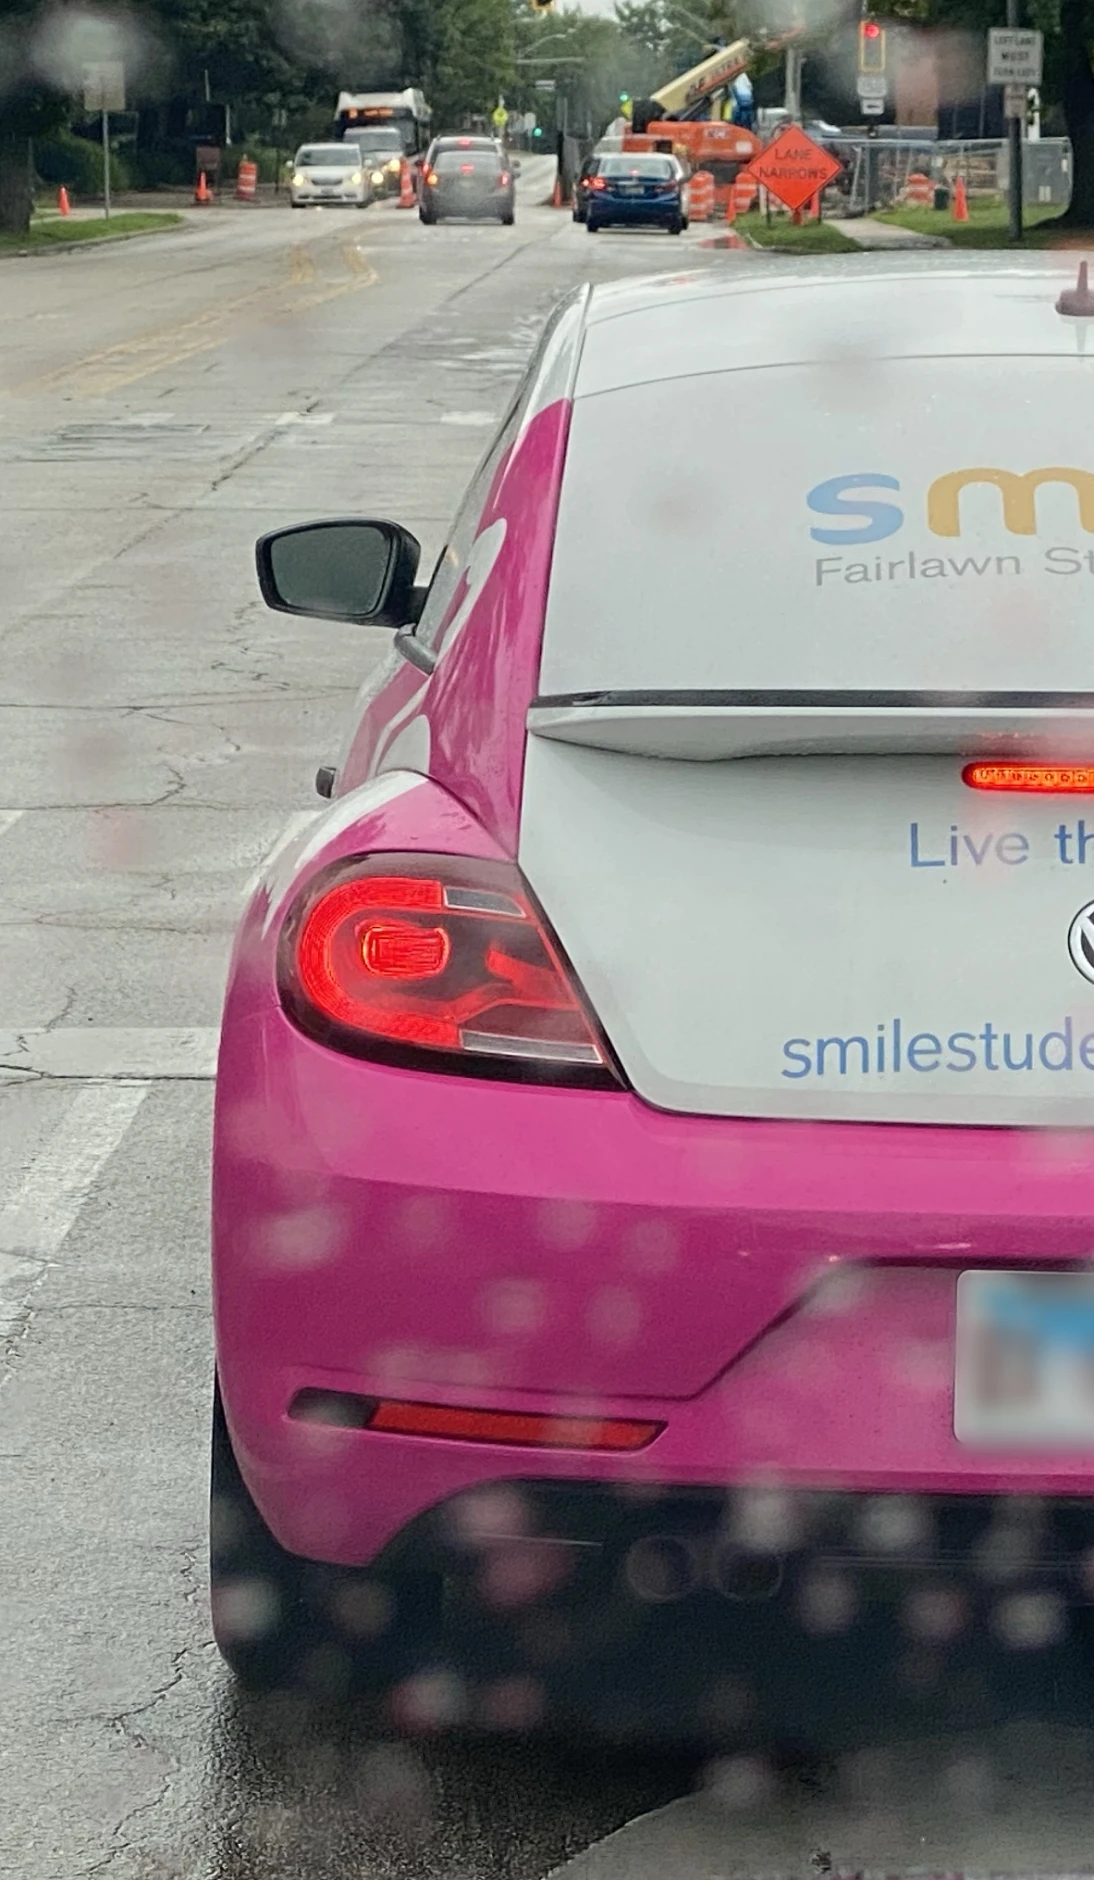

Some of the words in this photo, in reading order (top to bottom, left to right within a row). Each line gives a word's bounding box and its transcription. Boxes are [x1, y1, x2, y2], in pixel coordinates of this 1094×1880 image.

[1001, 51, 1030, 61] MUST
[774, 148, 813, 161] LANE
[759, 166, 828, 180] NARROWS
[815, 550, 1021, 588] Fairlawn
[910, 821, 1030, 868] Live
